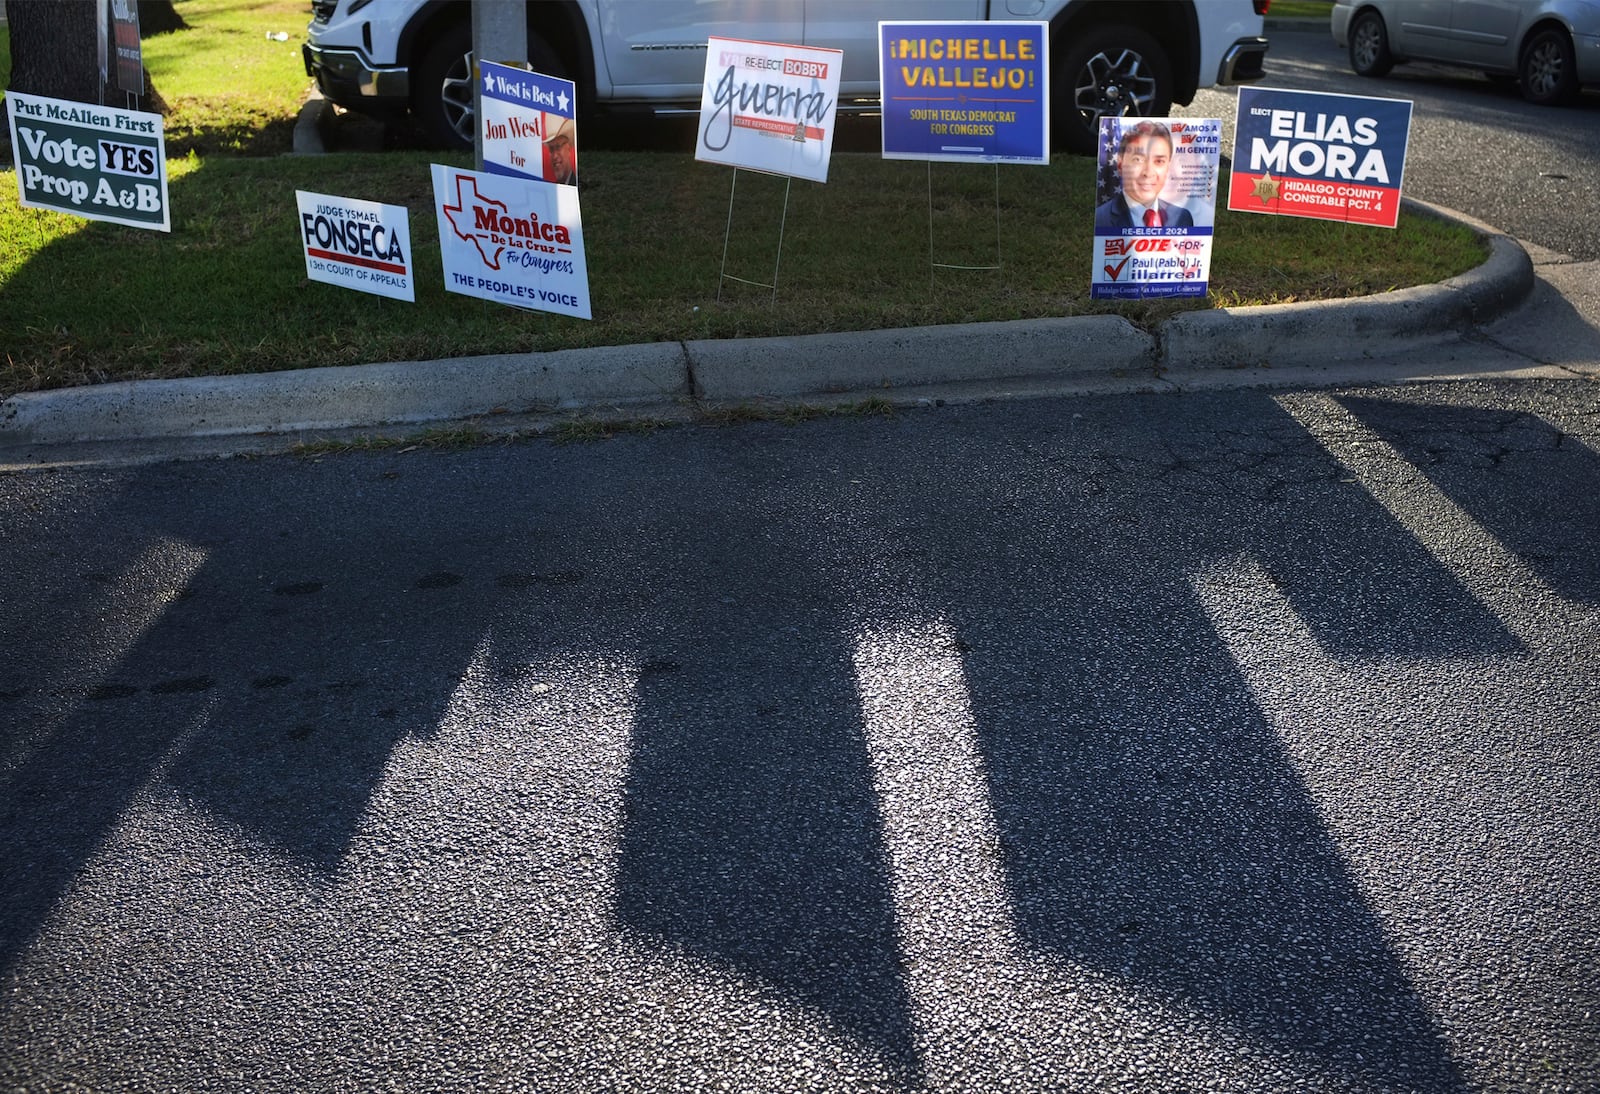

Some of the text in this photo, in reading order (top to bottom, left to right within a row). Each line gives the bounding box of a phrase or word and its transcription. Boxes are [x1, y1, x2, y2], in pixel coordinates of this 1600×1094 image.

[745, 56, 783, 71] RE-ELECT
[785, 60, 826, 78] BOBBY
[901, 67, 1034, 89] VALLEJO!
[496, 76, 555, 107] West is Best
[14, 98, 155, 133] Put McAllen First
[910, 109, 1016, 123] SOUTH TEXAS DEMOCRAT
[1250, 107, 1271, 116] ELECT
[485, 116, 541, 140] Jon West
[734, 117, 794, 134] STATE REPRESENTATIVE
[931, 123, 995, 136] FOR CONGRESS
[1270, 109, 1378, 146] ELIAS
[18, 127, 154, 175] Vote YES
[510, 150, 526, 167] For
[1175, 146, 1217, 154] MI GENTE!
[1250, 137, 1390, 184] MORA
[23, 164, 89, 205] Prop
[1258, 182, 1273, 195] FOR
[1284, 181, 1384, 200] HIDALGO COUNTY
[1283, 192, 1382, 212] CONSTABLE PCT. 4
[316, 204, 380, 223] JUDGE YSMAEL
[472, 205, 571, 245] Monica
[1165, 227, 1188, 235] 2024
[302, 212, 405, 264] FONSECA
[491, 233, 556, 254] De La Cruz
[506, 250, 574, 275] For Congress
[1132, 258, 1203, 269] Paul (Pablo) Jr.
[309, 260, 407, 289] 13th COURT OF APPEALS
[452, 272, 475, 287] THE
[478, 278, 536, 299] PEOPLE'S
[538, 290, 579, 307] VOICE
